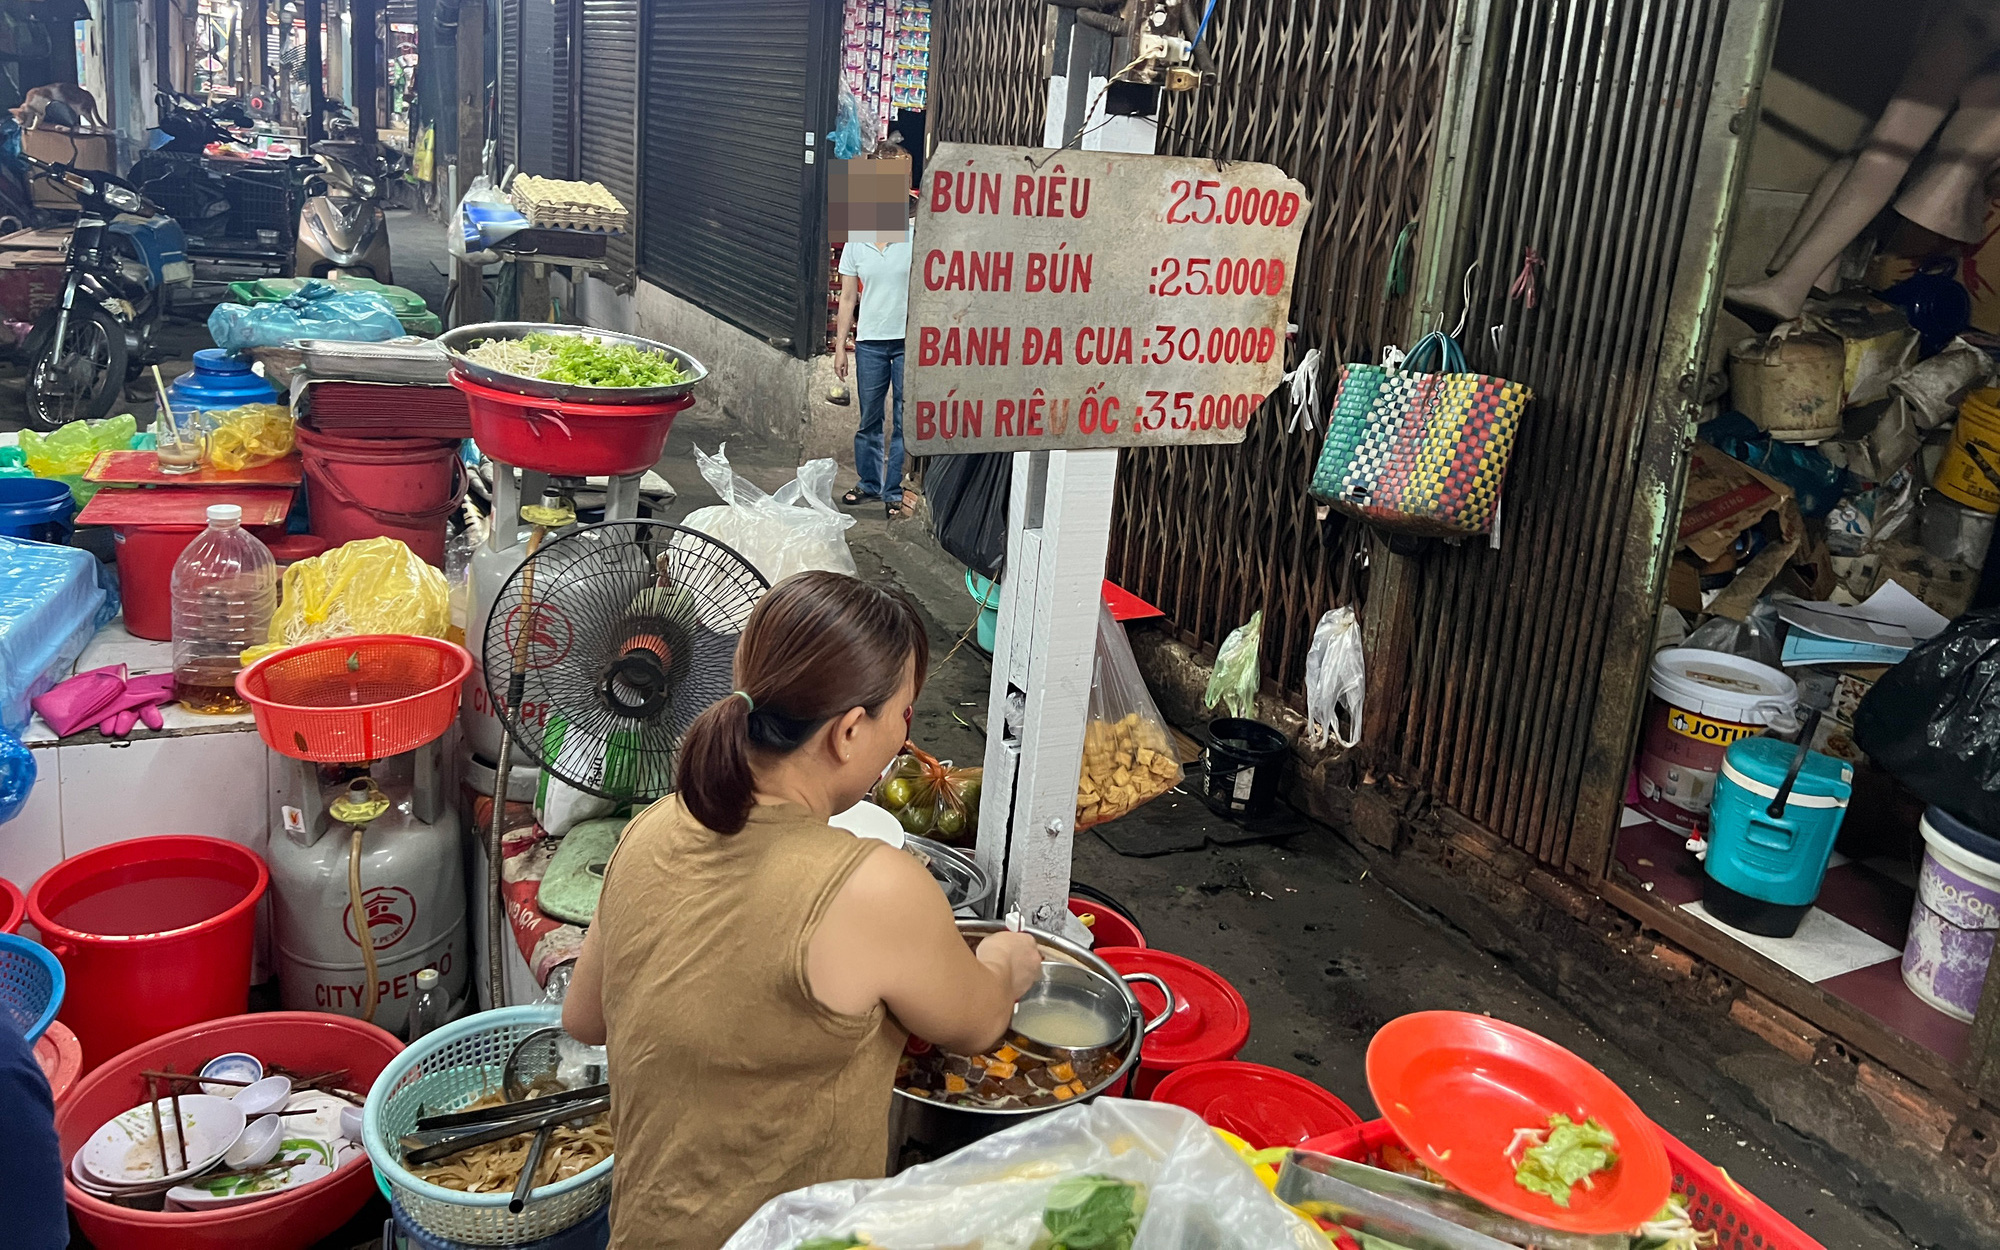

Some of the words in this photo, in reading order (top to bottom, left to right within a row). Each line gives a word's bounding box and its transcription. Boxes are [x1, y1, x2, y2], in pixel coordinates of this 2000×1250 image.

[930, 158, 1002, 216] BÚN
[1012, 164, 1091, 219] RIÊU
[1166, 178, 1301, 228] 25.000Đ
[923, 248, 1014, 293] CANH
[1025, 241, 1093, 294] BÚN
[1021, 325, 1064, 366] ĐA
[1074, 325, 1133, 366] CUA
[915, 389, 983, 440] BÚN
[993, 387, 1070, 436] RIÊU
[1077, 381, 1121, 435] ỐC
[1690, 720, 1755, 742] JOTU
[315, 983, 365, 1008] CITY
